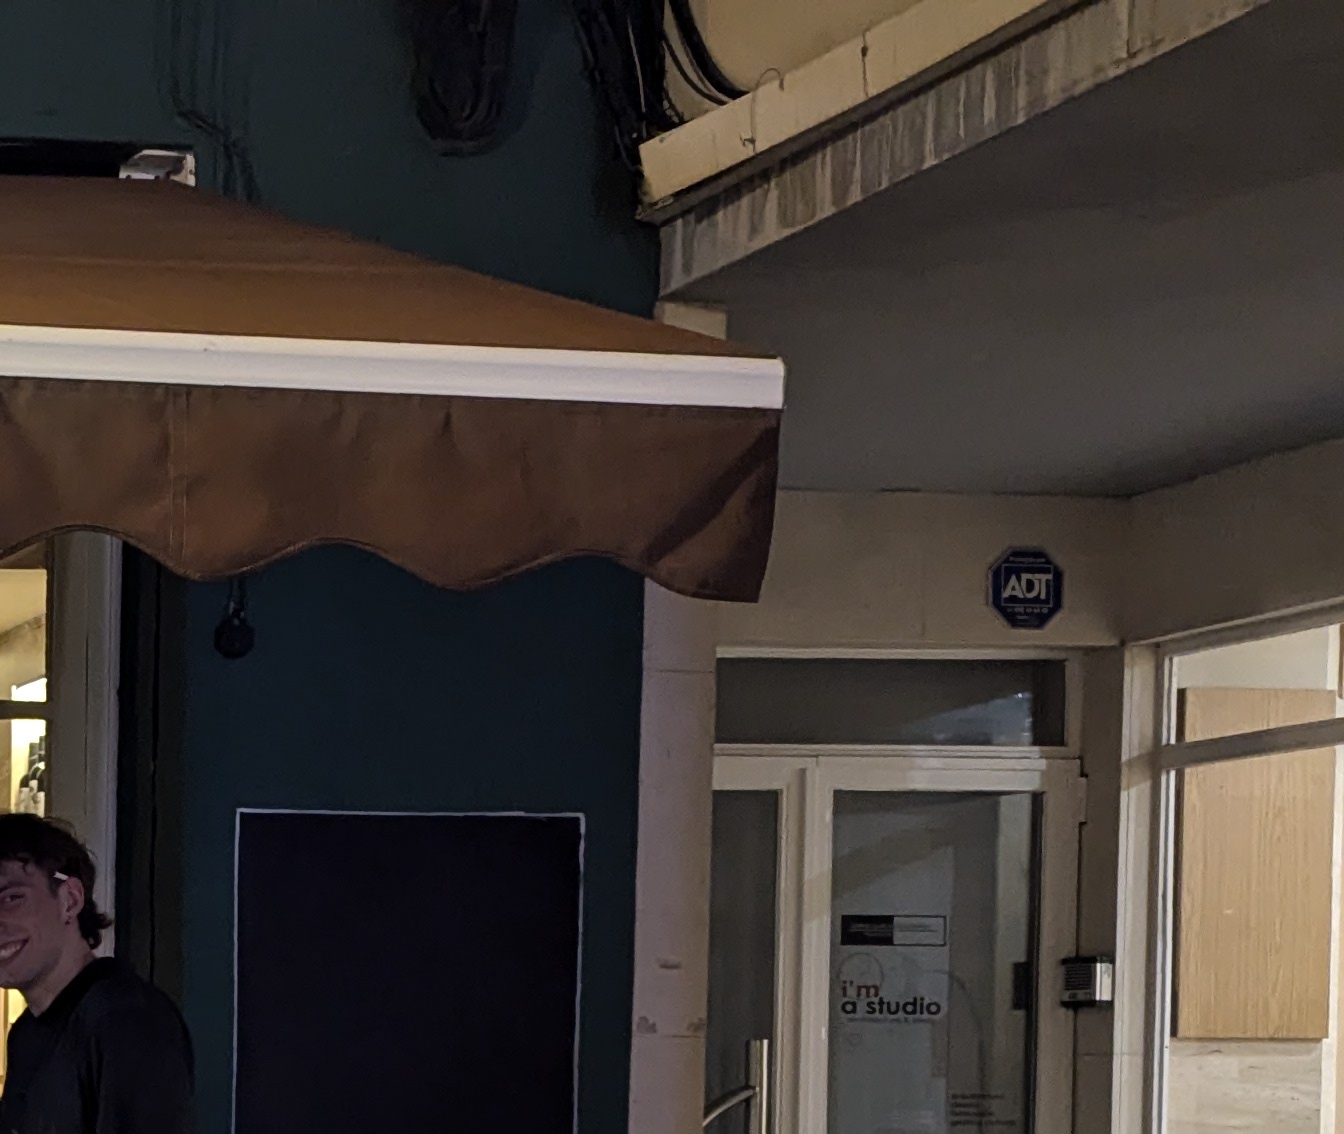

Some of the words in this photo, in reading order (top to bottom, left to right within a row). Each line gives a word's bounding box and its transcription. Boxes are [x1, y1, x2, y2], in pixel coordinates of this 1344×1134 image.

[1002, 573, 1053, 600] ADT
[841, 980, 880, 998] i'm
[840, 1000, 858, 1015] a
[866, 996, 942, 1016] studio
